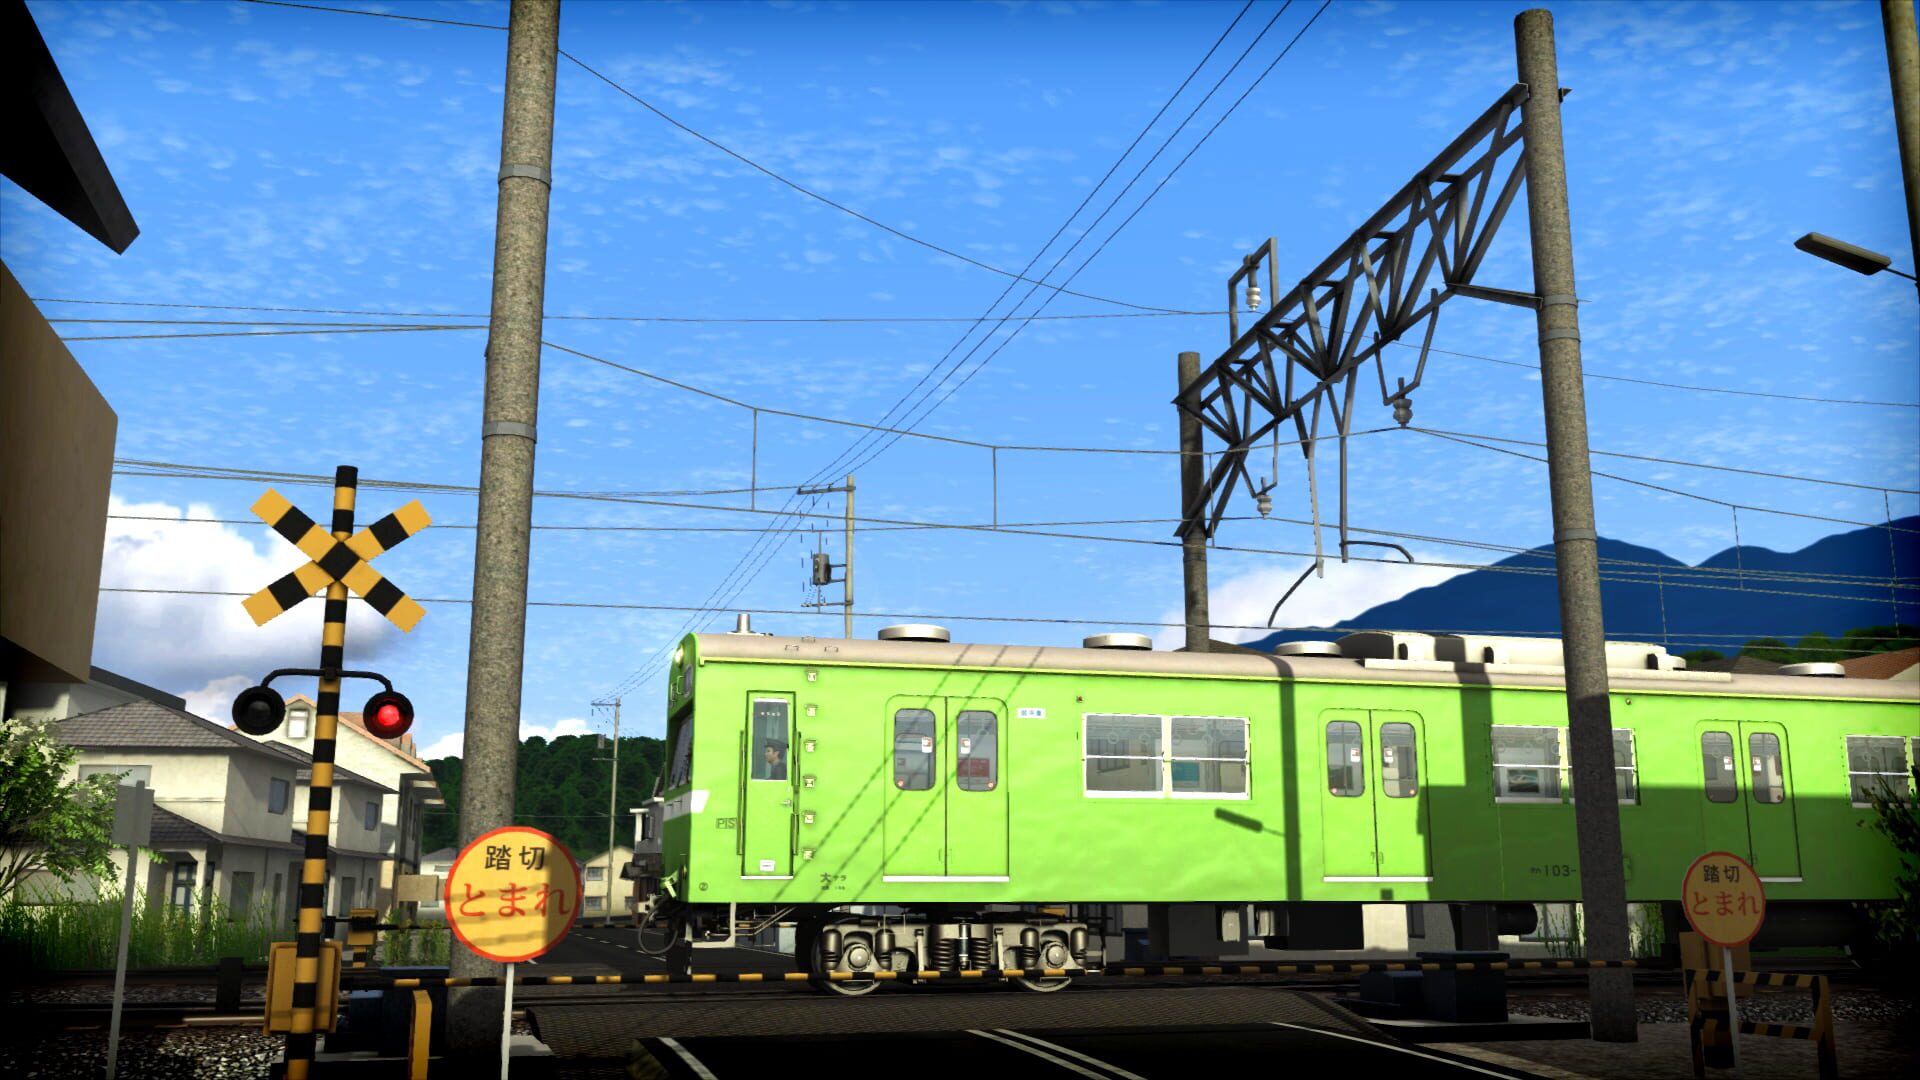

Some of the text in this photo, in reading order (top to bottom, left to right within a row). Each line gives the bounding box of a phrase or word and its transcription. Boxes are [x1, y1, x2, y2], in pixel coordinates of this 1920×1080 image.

[484, 845, 545, 870] 踏切
[1703, 865, 1740, 883] 踏切
[459, 882, 570, 917] とまれ
[1693, 891, 1760, 916] とまれ
